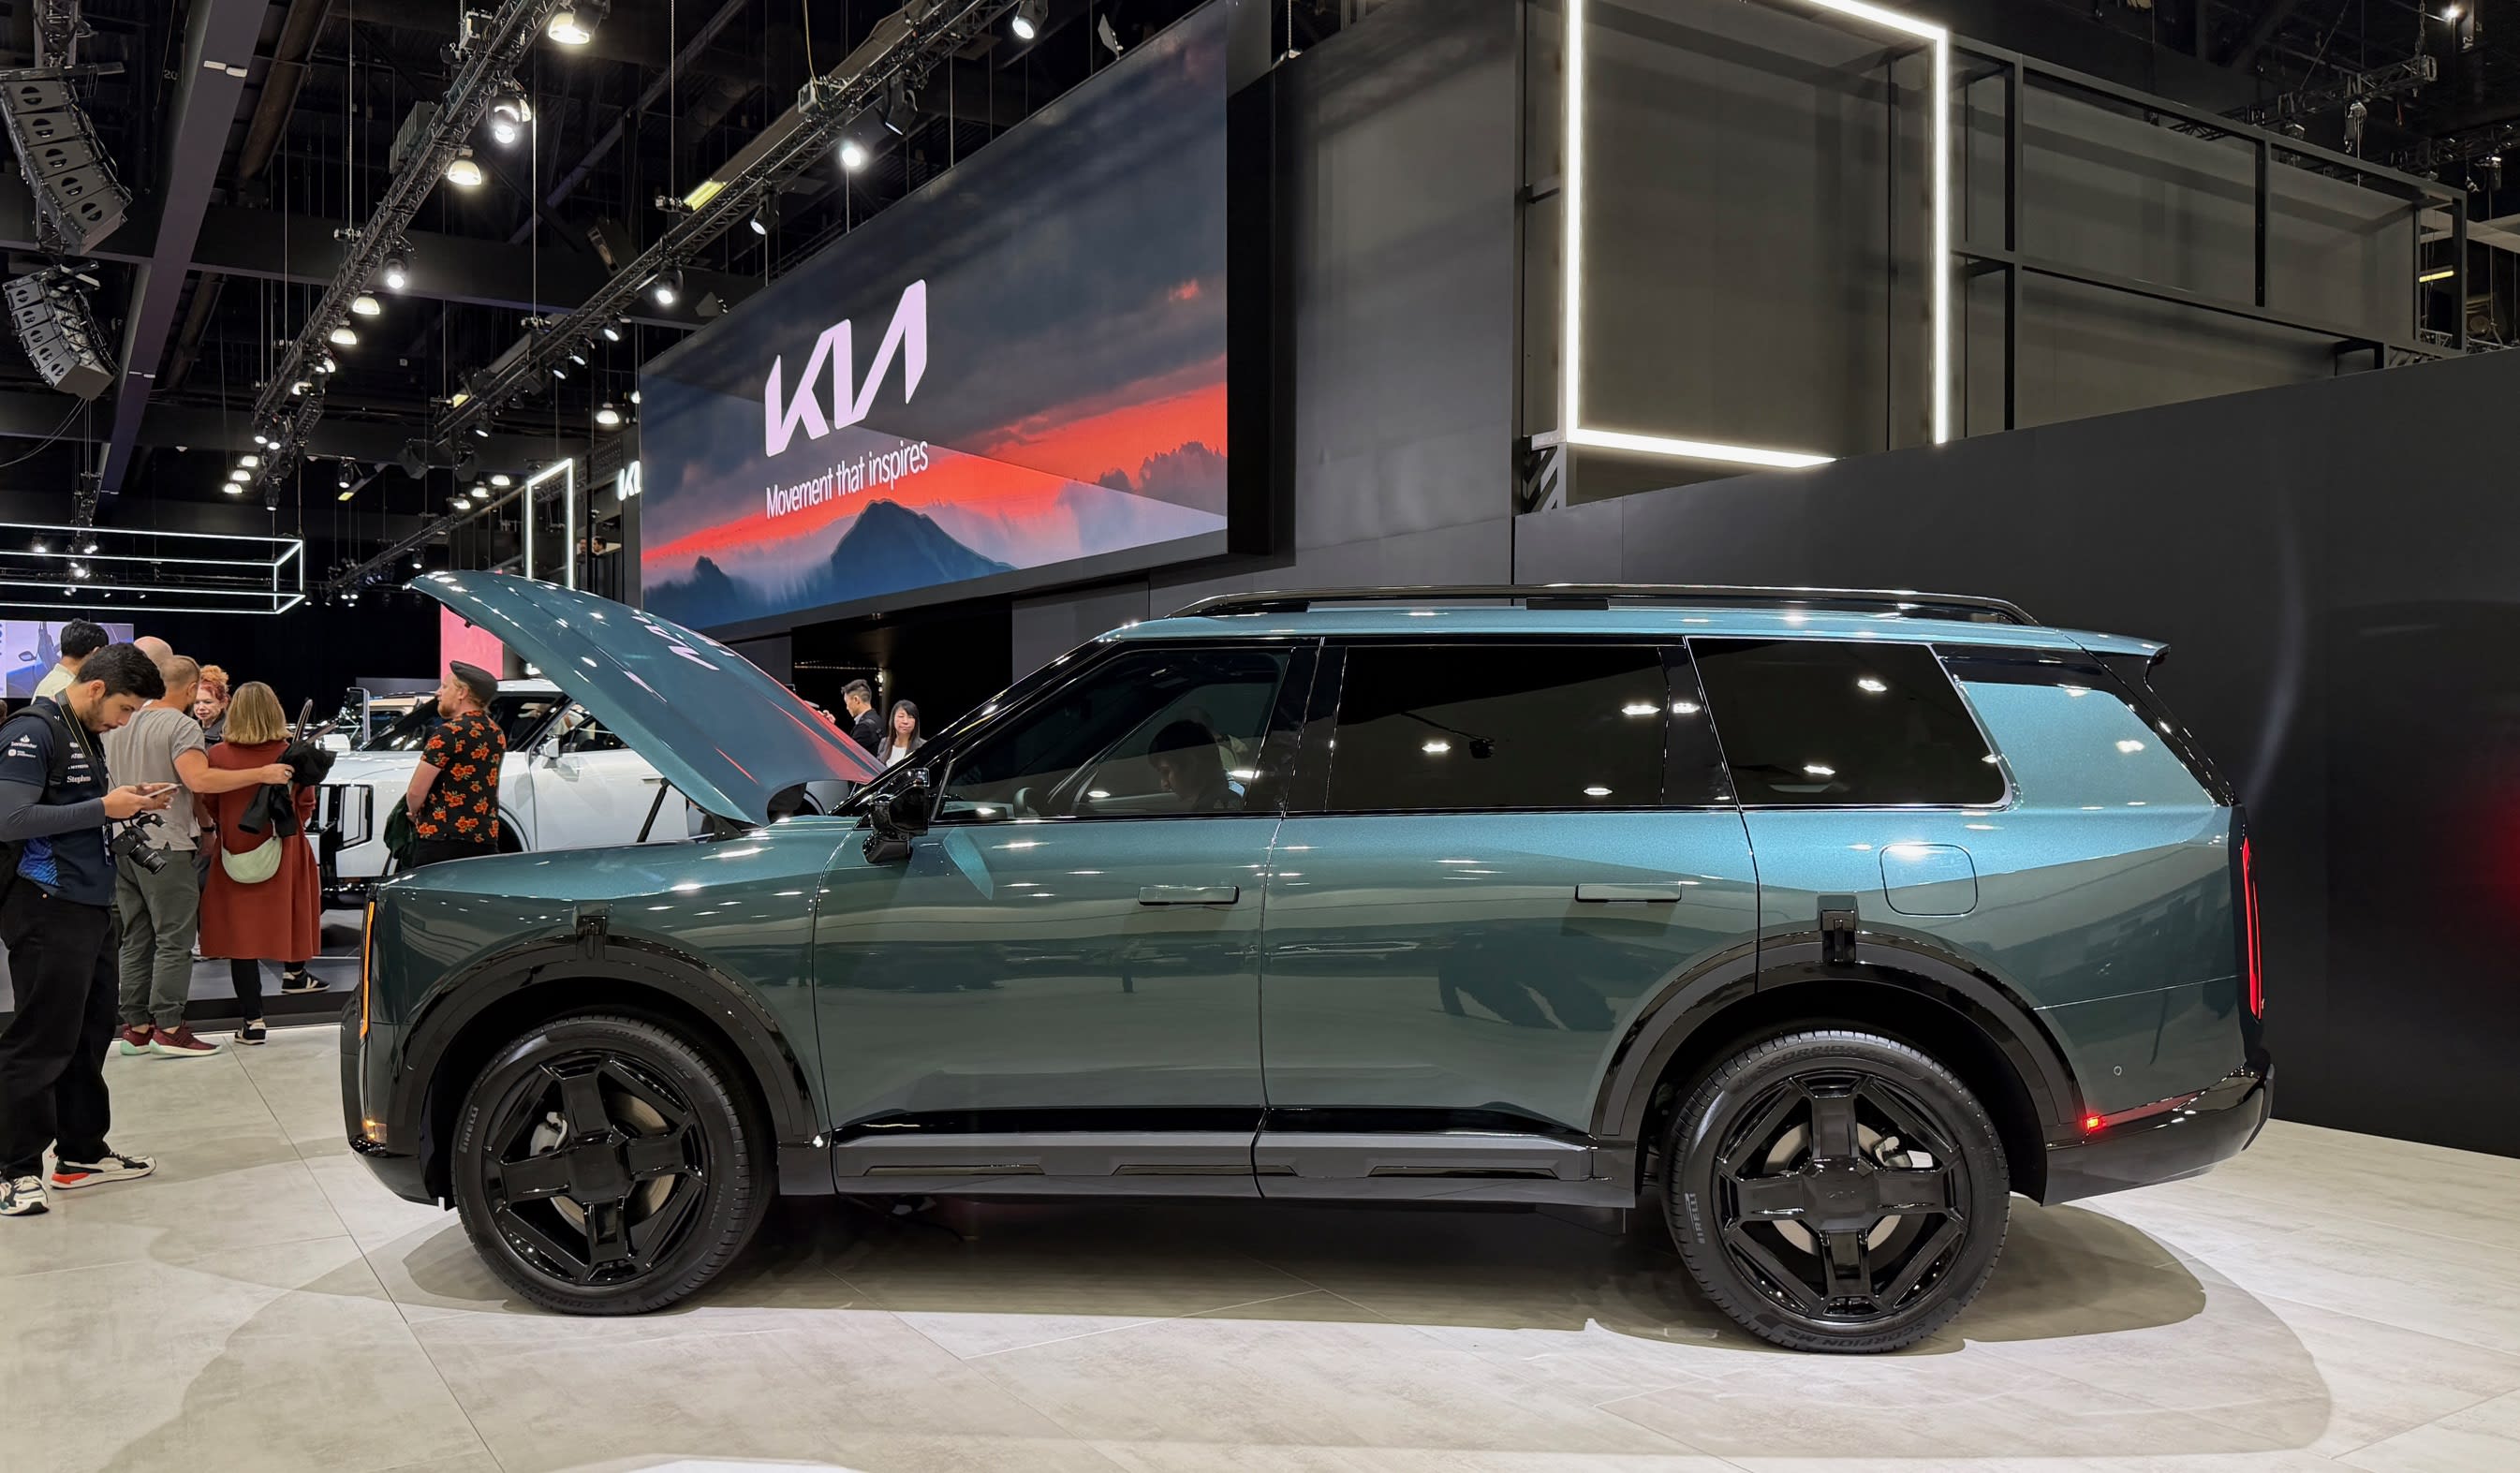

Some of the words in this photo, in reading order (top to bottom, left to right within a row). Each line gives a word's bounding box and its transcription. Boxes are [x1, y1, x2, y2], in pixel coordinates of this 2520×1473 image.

[765, 279, 927, 457] KIA
[766, 467, 833, 519] Movement
[836, 455, 865, 496] that
[868, 439, 929, 490] inspires
